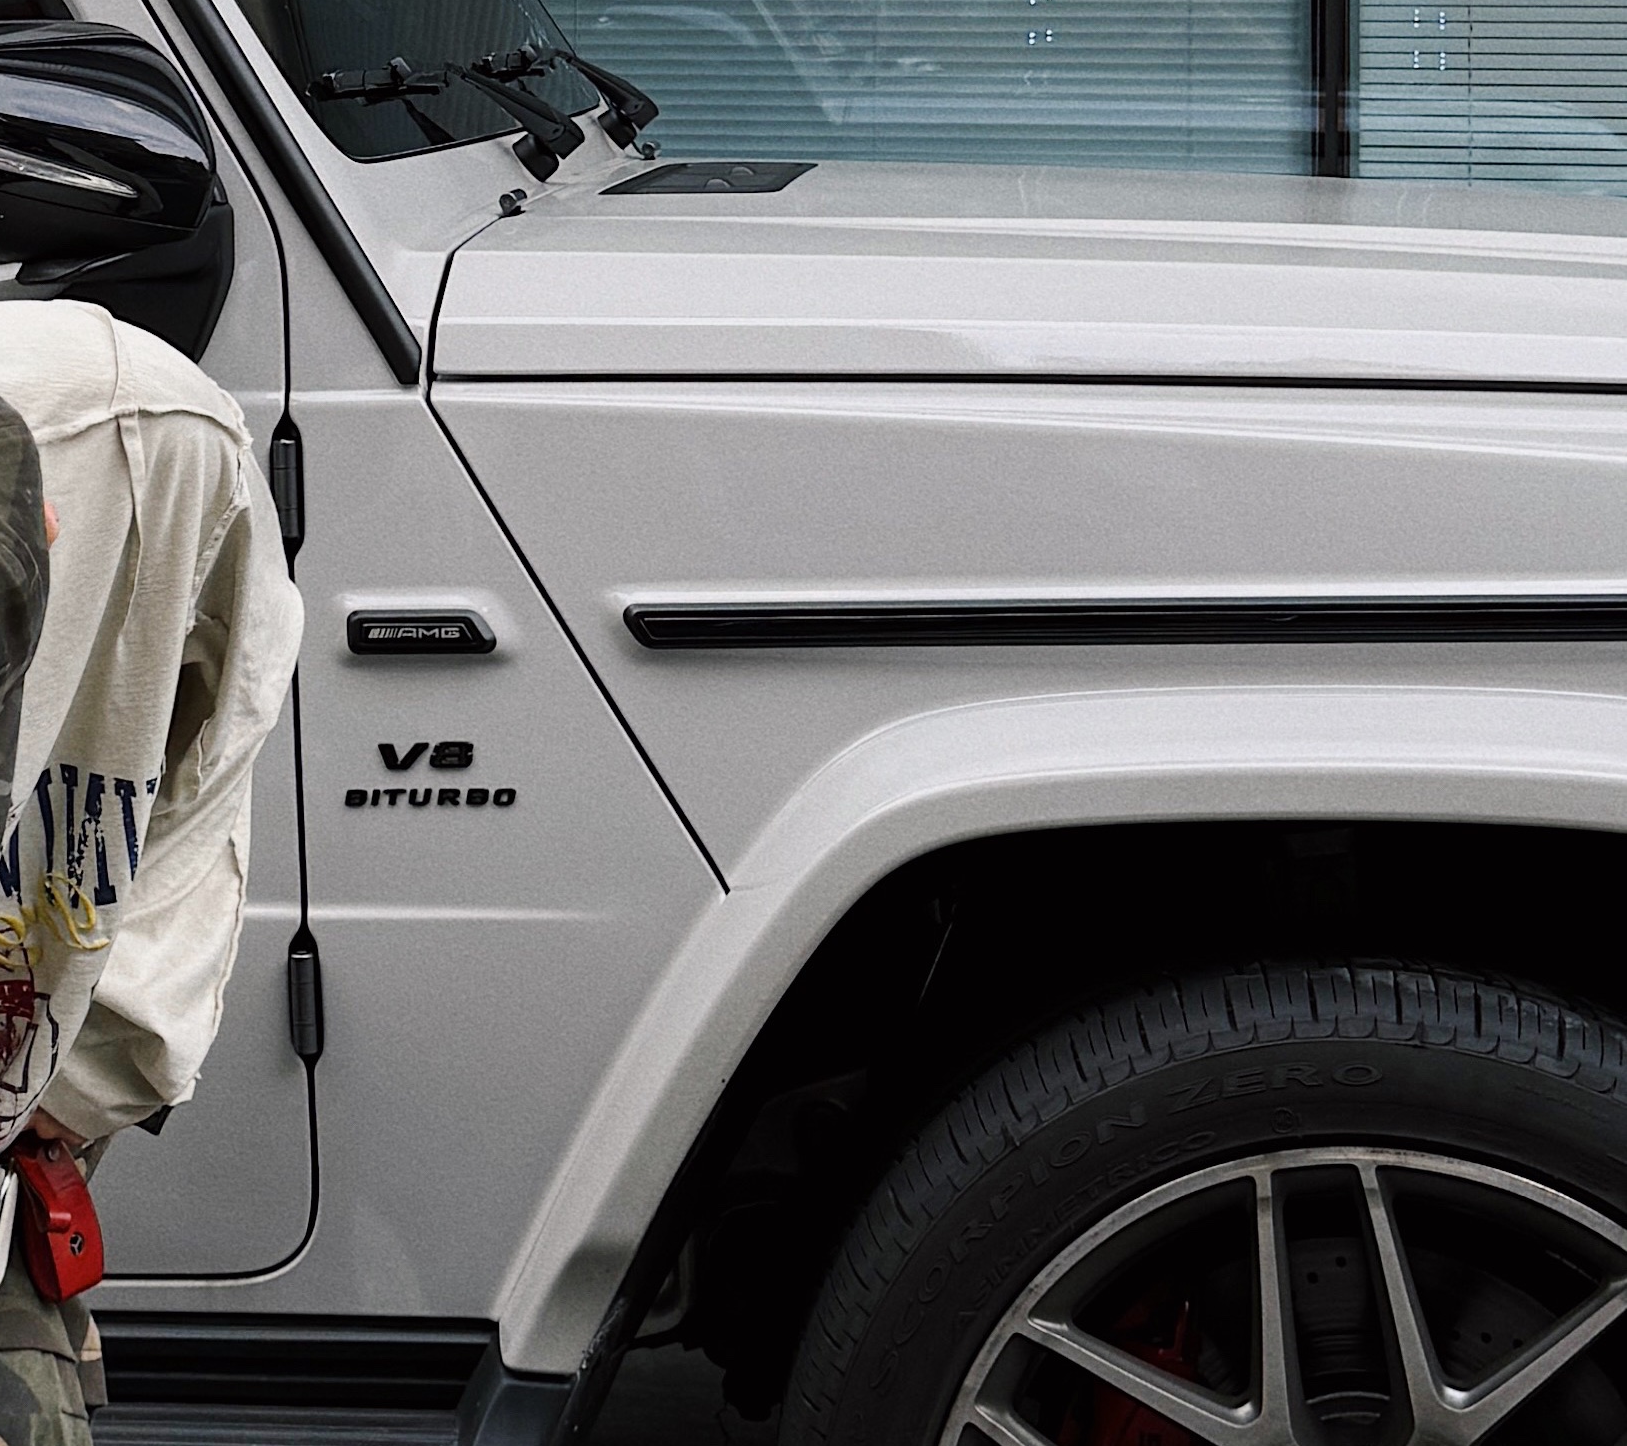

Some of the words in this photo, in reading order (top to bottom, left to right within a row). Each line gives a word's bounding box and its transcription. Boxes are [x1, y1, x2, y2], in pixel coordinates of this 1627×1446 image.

[396, 627, 461, 639] AMG
[378, 741, 474, 771] V8
[344, 788, 517, 806] BITURBO
[868, 1101, 1150, 1392] SCORPION
[1164, 1061, 1386, 1114] ZERO
